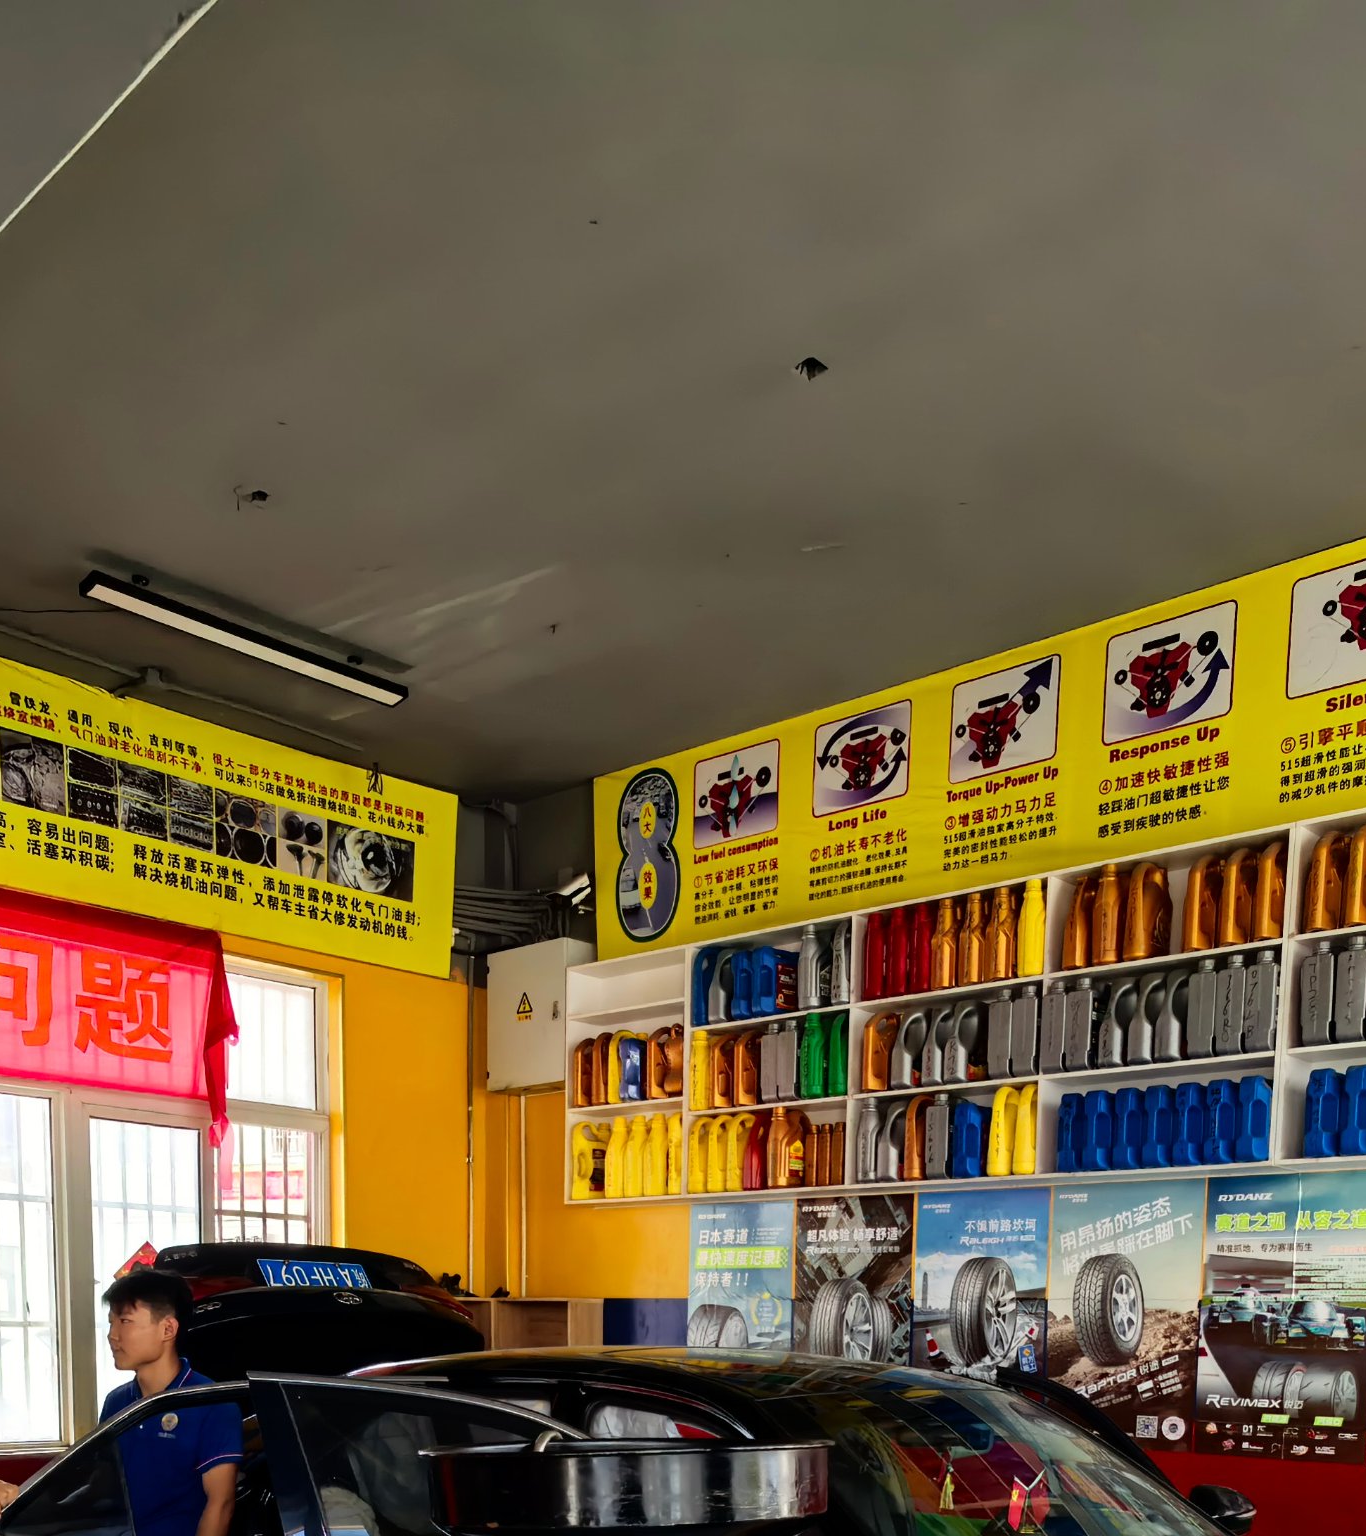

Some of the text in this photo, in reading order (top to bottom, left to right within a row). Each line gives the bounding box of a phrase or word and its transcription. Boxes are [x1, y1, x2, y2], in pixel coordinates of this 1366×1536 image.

[1109, 726, 1220, 763] Response Up
[946, 766, 1059, 803] Torque Up-Power Up
[828, 809, 887, 831] Long Life
[694, 836, 778, 864] Low fuel consumption
[1218, 1192, 1274, 1202] RYDANZ
[698, 1228, 749, 1245] 日本赛道
[964, 1218, 1037, 1233] 不惧前路坎坷
[1060, 1196, 1172, 1254] 用昂扬的姿态
